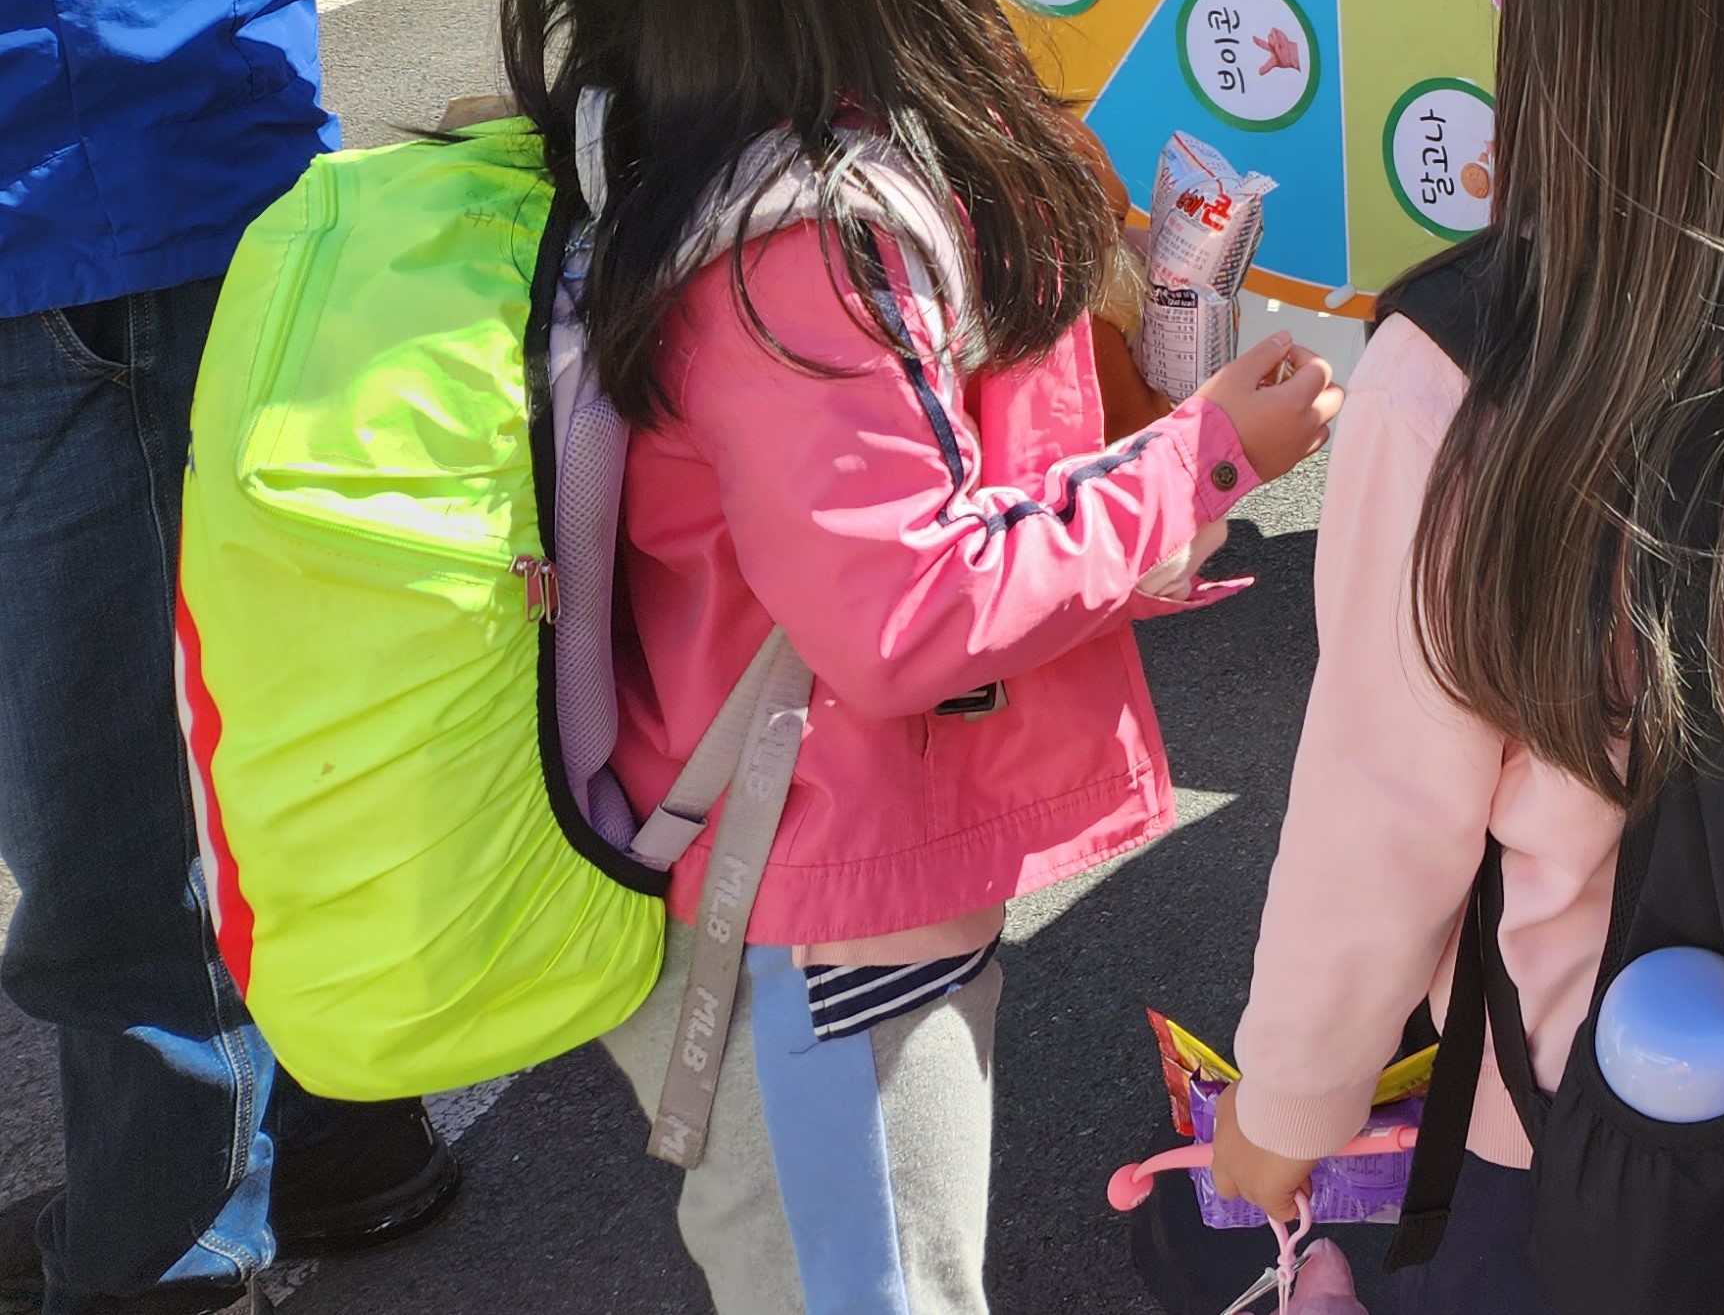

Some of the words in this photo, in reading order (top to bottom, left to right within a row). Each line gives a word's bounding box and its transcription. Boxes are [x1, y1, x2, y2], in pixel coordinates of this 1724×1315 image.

[1207, 6, 1246, 94] 브이콘
[1419, 108, 1455, 205] 달고나
[706, 853, 750, 945] MLB
[681, 986, 720, 1073] MLB
